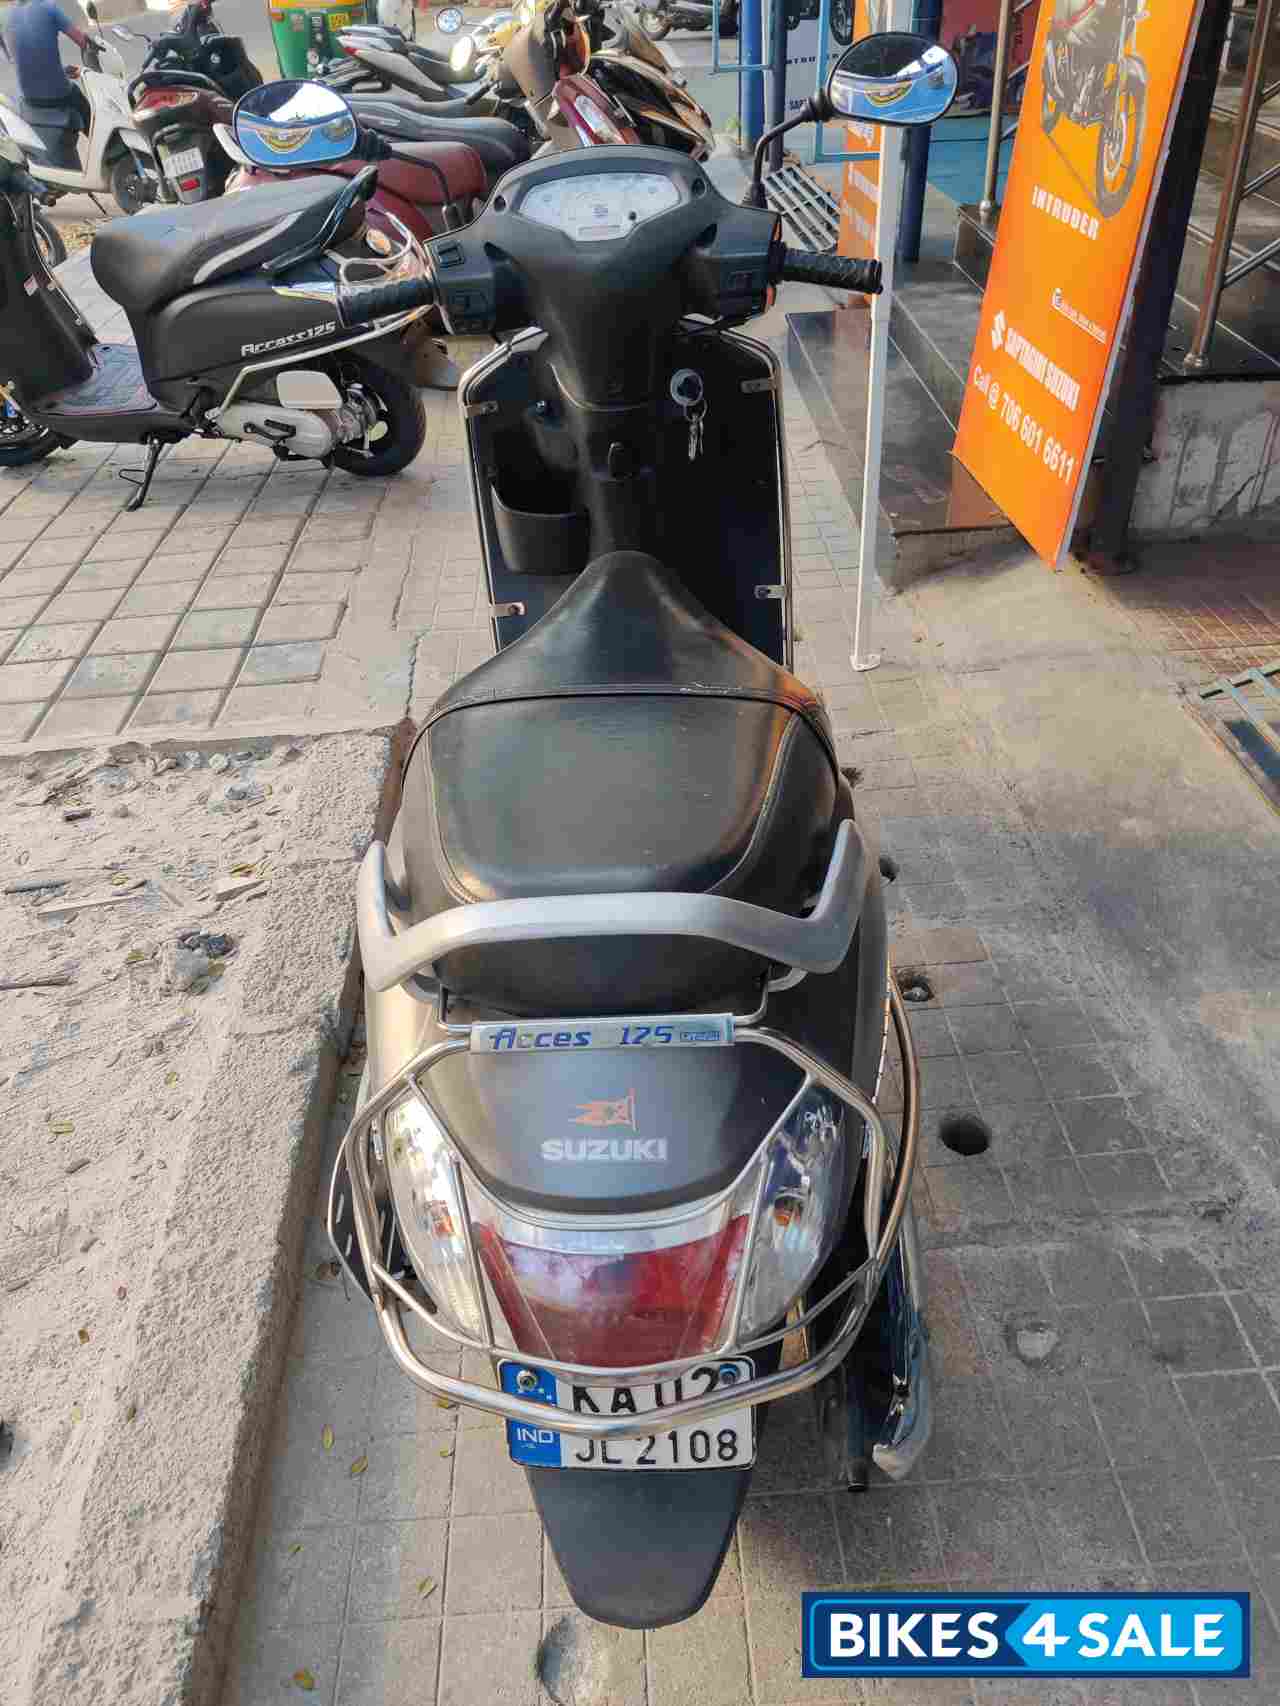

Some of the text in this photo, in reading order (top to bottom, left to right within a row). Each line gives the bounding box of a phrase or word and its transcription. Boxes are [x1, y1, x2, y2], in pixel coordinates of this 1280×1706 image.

[1032, 184, 1099, 241] INTRUDER
[973, 364, 993, 396] Call
[988, 381, 1001, 410] @
[1001, 391, 1022, 433] 706
[1021, 414, 1043, 456] 601
[617, 1023, 675, 1046] 125
[540, 1137, 668, 1161] SUZUKI
[516, 1427, 554, 1443] IND
[635, 1429, 738, 1465] 2108
